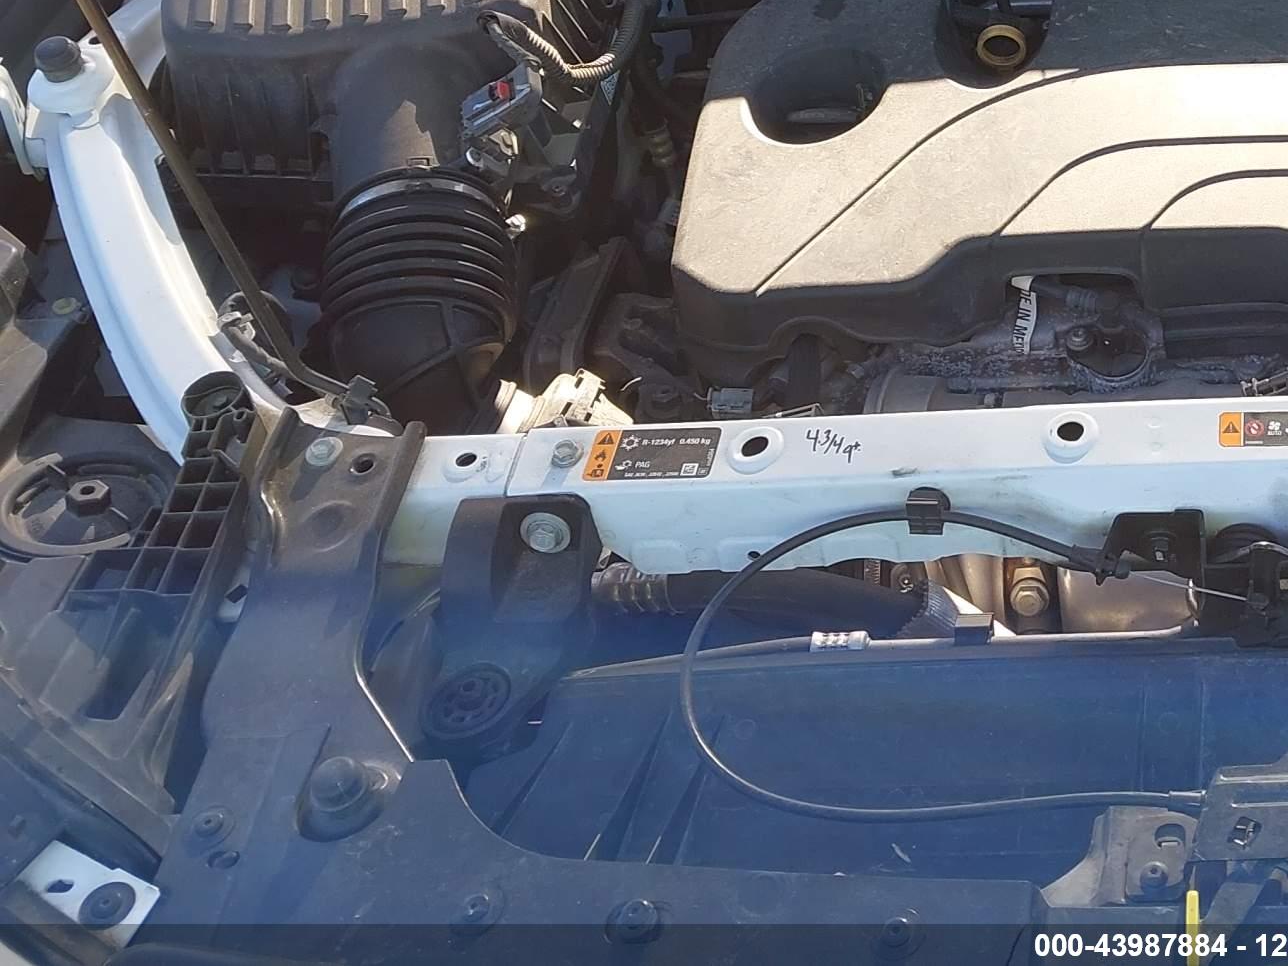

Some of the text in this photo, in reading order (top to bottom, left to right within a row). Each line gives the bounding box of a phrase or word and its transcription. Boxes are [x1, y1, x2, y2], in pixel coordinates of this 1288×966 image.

[1017, 307, 1032, 322] IN
[700, 438, 711, 446] kg
[634, 460, 651, 469] PAG
